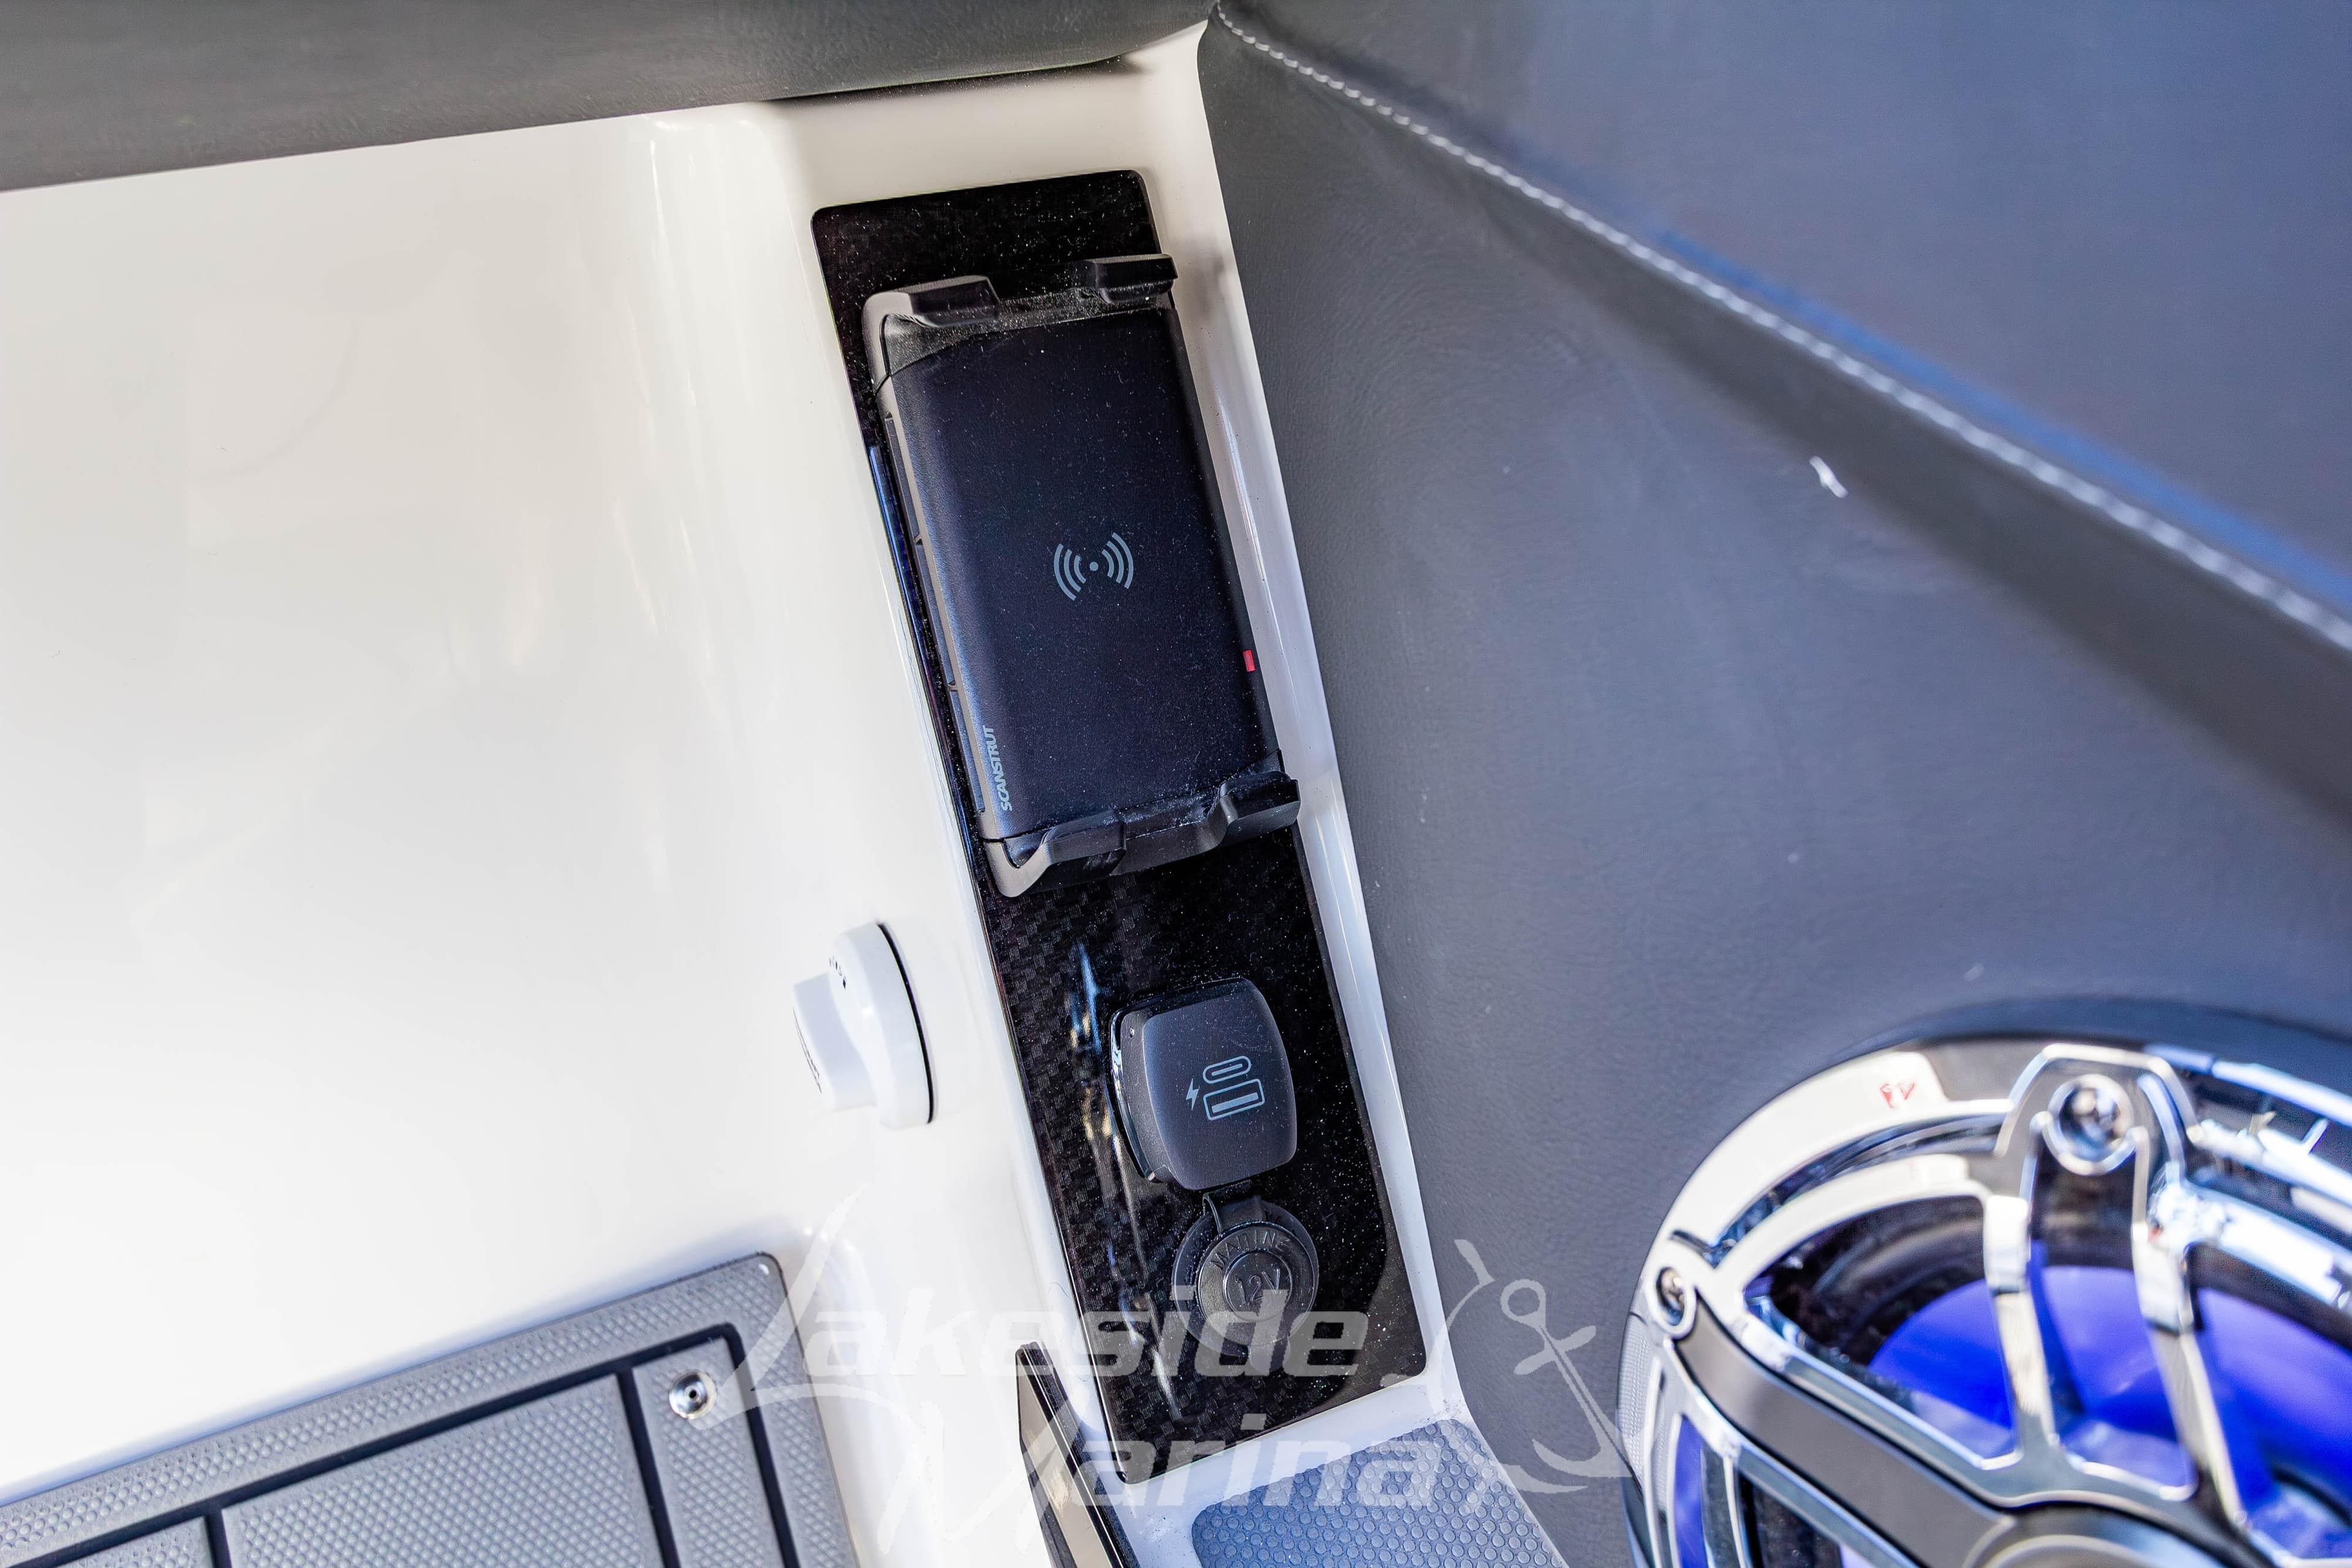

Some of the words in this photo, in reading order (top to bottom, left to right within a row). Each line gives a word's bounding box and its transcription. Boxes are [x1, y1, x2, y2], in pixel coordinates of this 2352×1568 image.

[982, 725, 1012, 812] SCANSTRUT
[1210, 1229, 1291, 1271] MARINE
[1234, 1268, 1281, 1305] 12V
